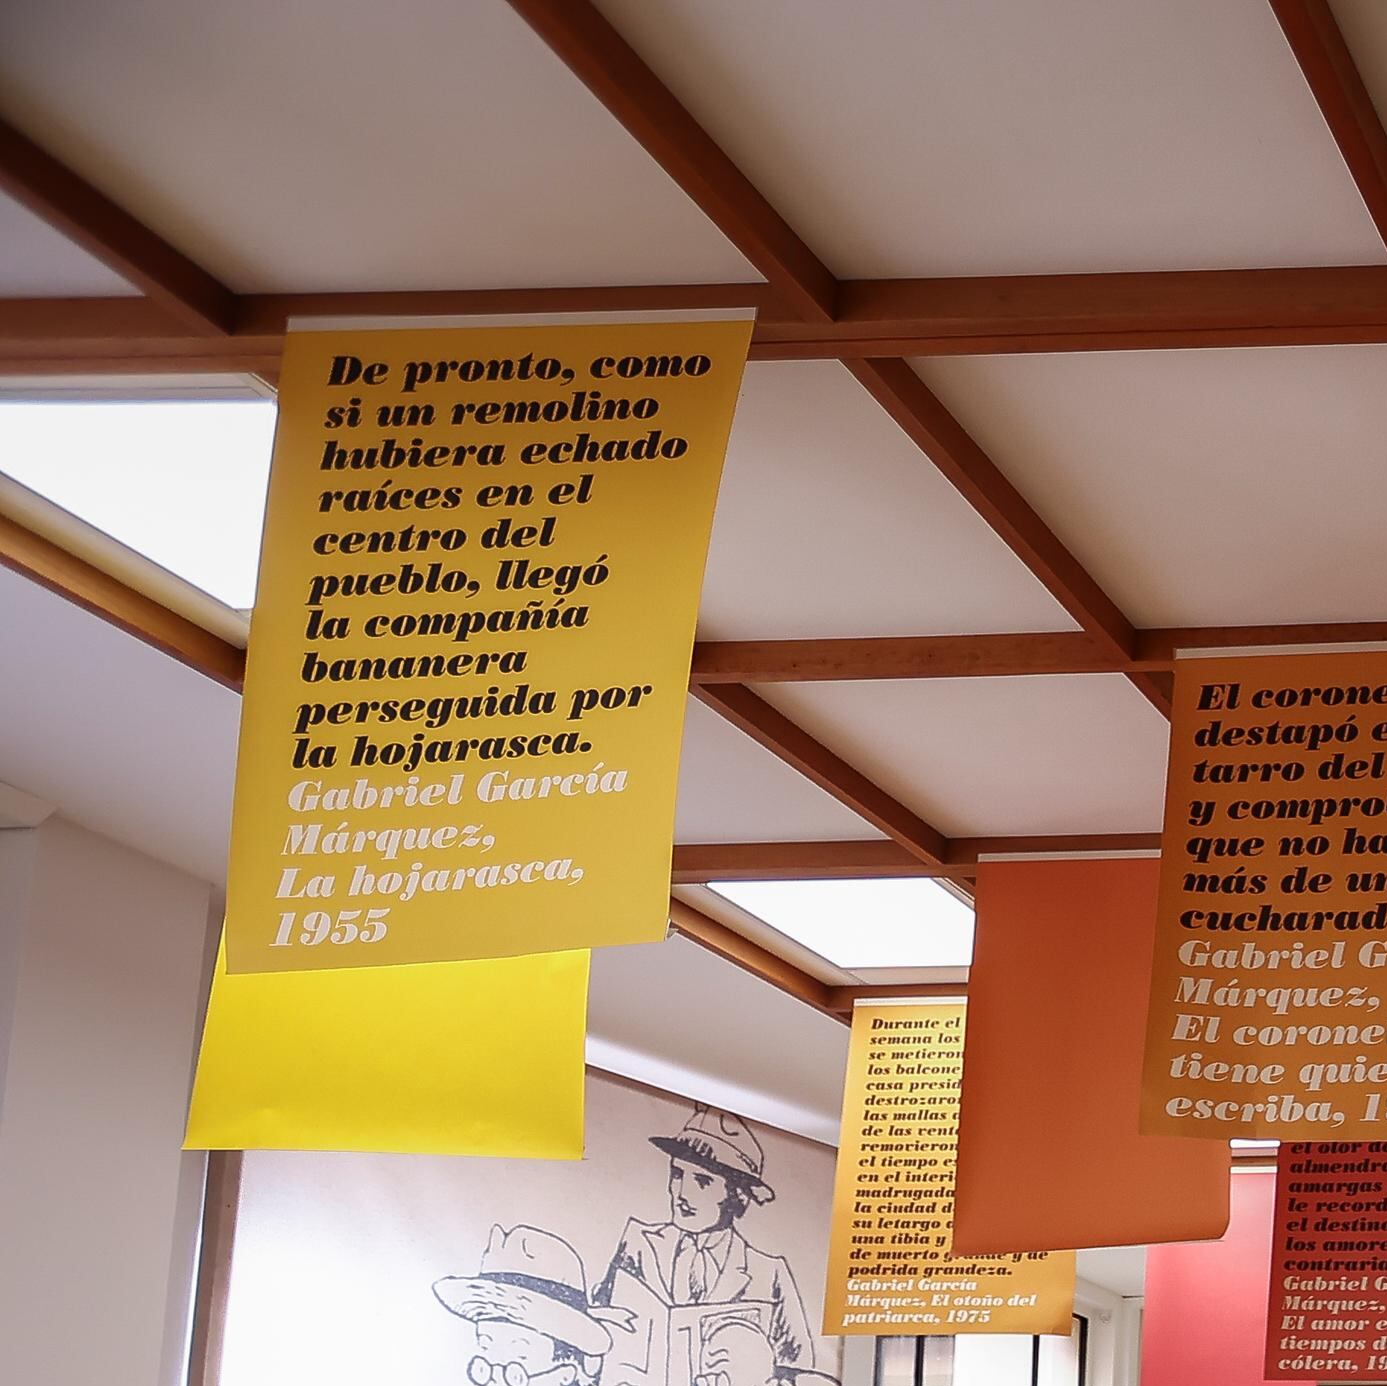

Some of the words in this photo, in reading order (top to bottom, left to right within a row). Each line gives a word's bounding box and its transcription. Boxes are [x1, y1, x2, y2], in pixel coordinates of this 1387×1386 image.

[330, 356, 388, 384] De
[405, 353, 574, 391] pronto,
[591, 355, 711, 378] como
[325, 398, 361, 427] si
[378, 405, 434, 426] un
[452, 391, 659, 424] remolino
[321, 438, 505, 470] hubiera
[521, 431, 688, 464] echado
[1196, 683, 1241, 711] El
[1194, 714, 1359, 751] destapó
[1192, 759, 1305, 784] tarro
[1318, 751, 1386, 781] del
[288, 766, 465, 812] Gabriel
[476, 761, 628, 802] García
[280, 821, 495, 860] Márquez,
[275, 868, 335, 898] La
[348, 859, 584, 901] hojarasca,
[268, 908, 391, 947] 1955
[1178, 939, 1346, 970] Gabriel
[1174, 976, 1380, 1015] Márquez,
[871, 1018, 940, 1030] Durante
[945, 1017, 960, 1028] el
[1170, 1014, 1221, 1043] El
[869, 1036, 932, 1045] semana
[938, 1032, 959, 1044] los
[1170, 1052, 1285, 1084] tiene
[1165, 1095, 1345, 1128] escriba,
[1288, 1182, 1382, 1196] amargas
[1288, 1198, 1308, 1212] le
[1286, 1217, 1308, 1232] el
[851, 1235, 885, 1244] una
[890, 1232, 930, 1244] tibia
[934, 1236, 946, 1247] y
[1286, 1236, 1316, 1251] los
[847, 1263, 918, 1279] podrida
[922, 1263, 1012, 1278] grandeza.
[847, 1278, 914, 1292] Gabriel
[918, 1276, 978, 1291] García
[1283, 1275, 1369, 1291] Gabriel
[930, 1294, 950, 1307] El
[953, 1294, 1004, 1306] otoño
[1007, 1294, 1037, 1307] del
[1282, 1295, 1386, 1315] Márquez,
[841, 1310, 941, 1327] patriarca,
[945, 1309, 991, 1323] 1975
[1280, 1315, 1305, 1330] El
[1310, 1319, 1370, 1331] amor
[1280, 1335, 1367, 1355] tiempos
[1278, 1354, 1359, 1373] cólera,
